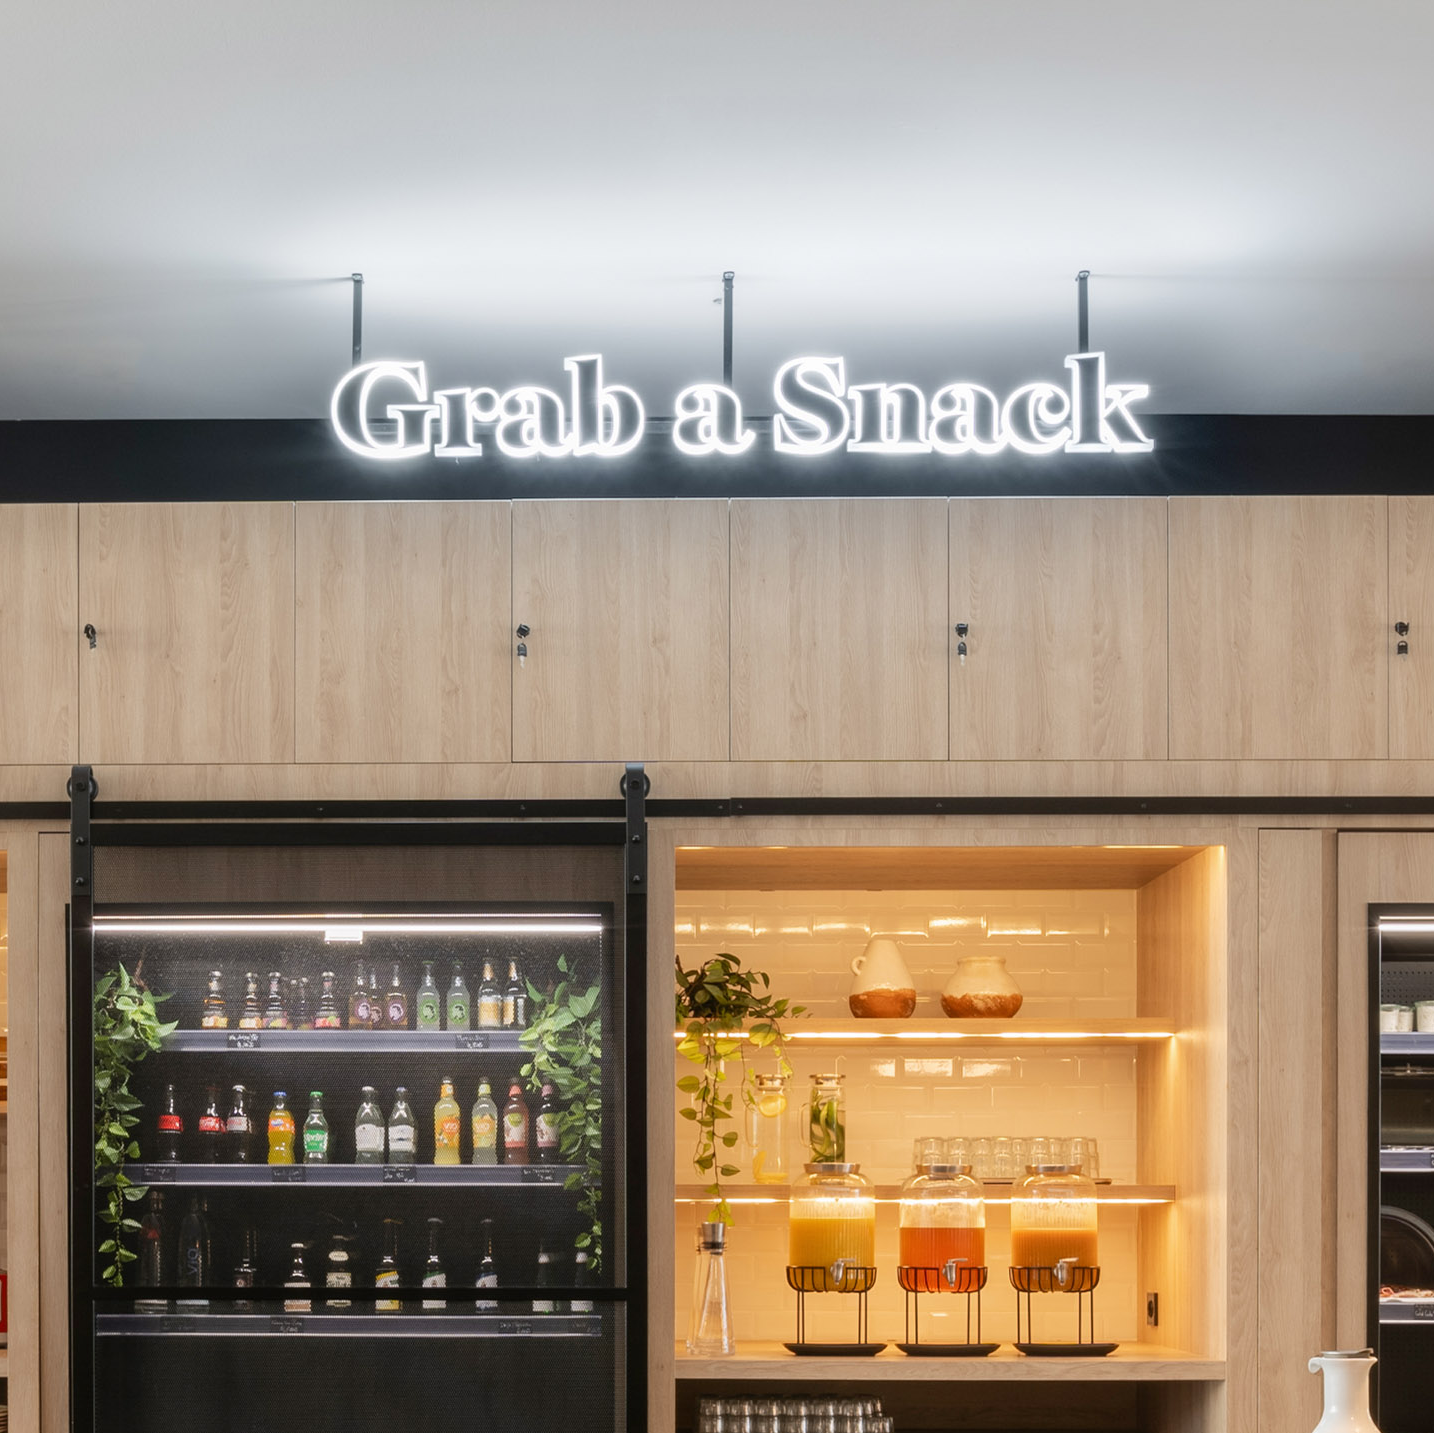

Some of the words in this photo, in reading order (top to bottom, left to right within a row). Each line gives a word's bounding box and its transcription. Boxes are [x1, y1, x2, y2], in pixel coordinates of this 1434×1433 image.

[329, 352, 647, 459] Grab
[671, 381, 757, 457] a
[772, 350, 1156, 457] Snack
